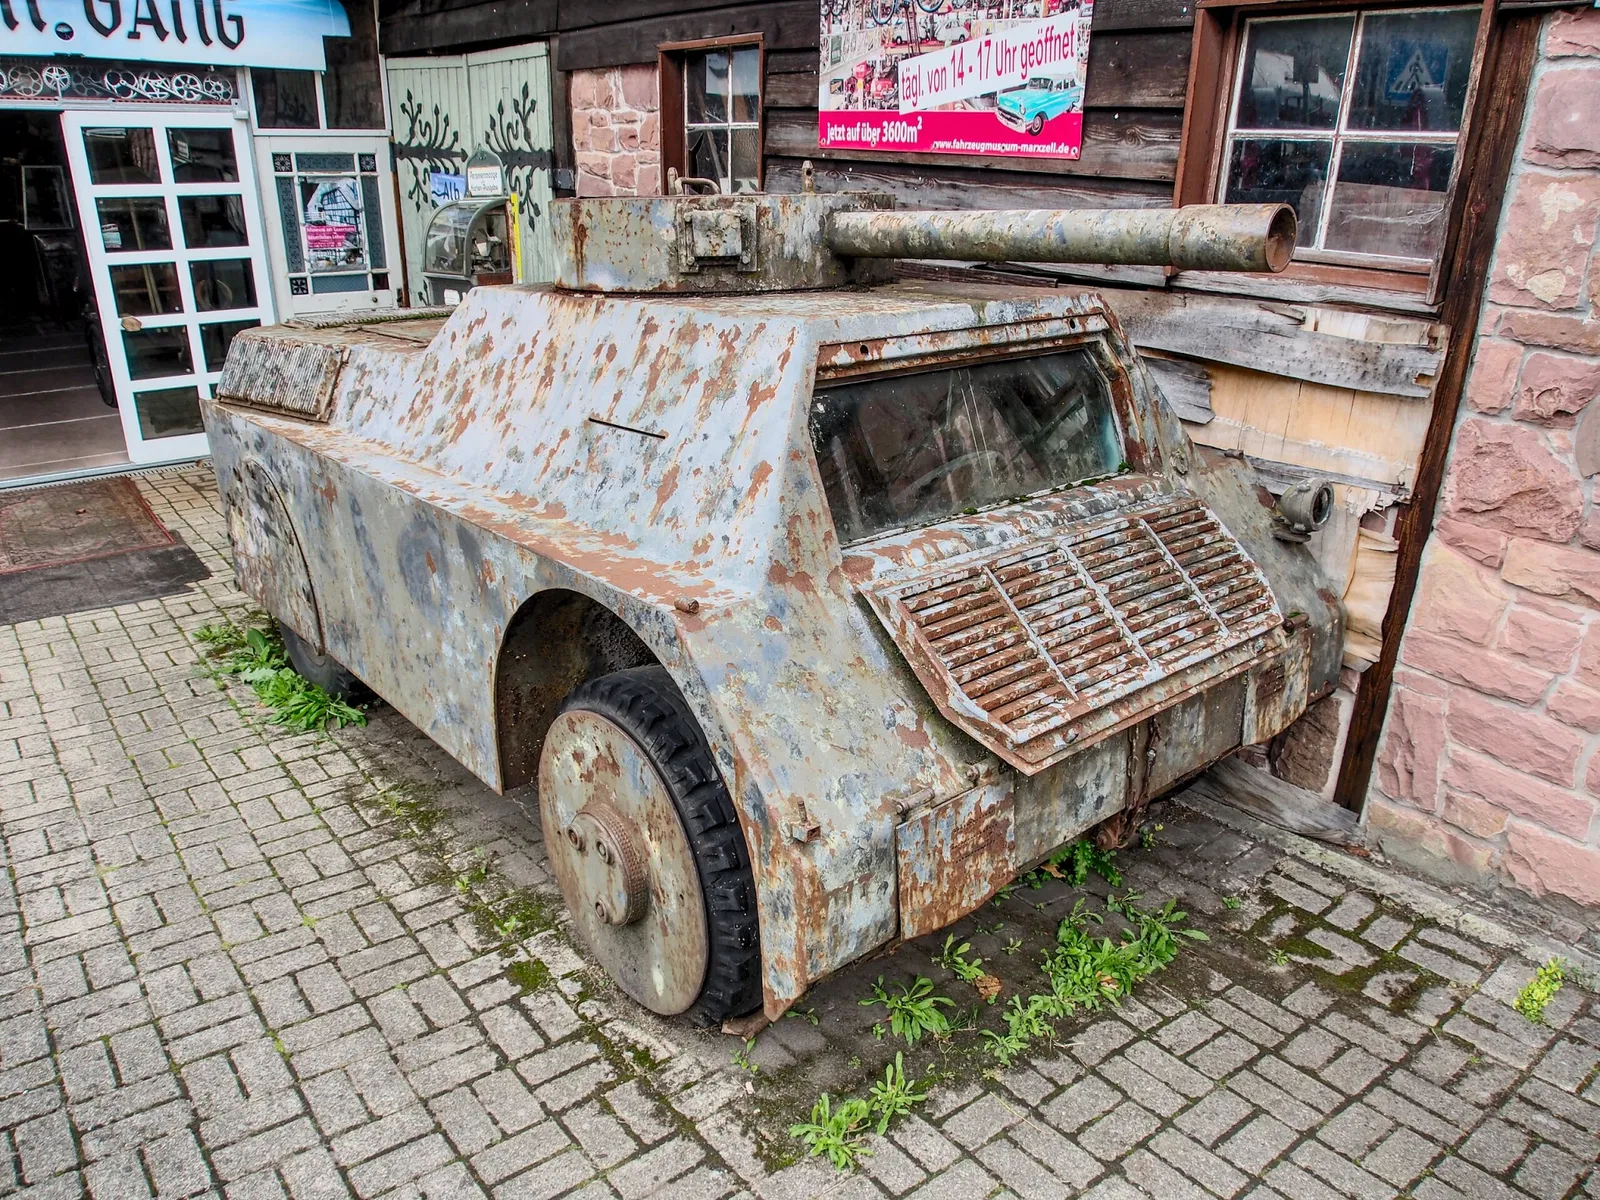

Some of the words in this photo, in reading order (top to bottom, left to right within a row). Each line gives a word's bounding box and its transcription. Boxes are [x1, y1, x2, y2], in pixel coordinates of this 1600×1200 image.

[902, 64, 924, 108] tägl.
[927, 67, 947, 94] von
[950, 46, 965, 86] 14
[968, 65, 974, 73] -
[977, 39, 992, 82] 17
[995, 36, 1018, 77] Uhr
[1020, 22, 1076, 80] geöffnet
[826, 121, 846, 146] jetzt
[847, 122, 861, 142] auf
[861, 122, 881, 143] über
